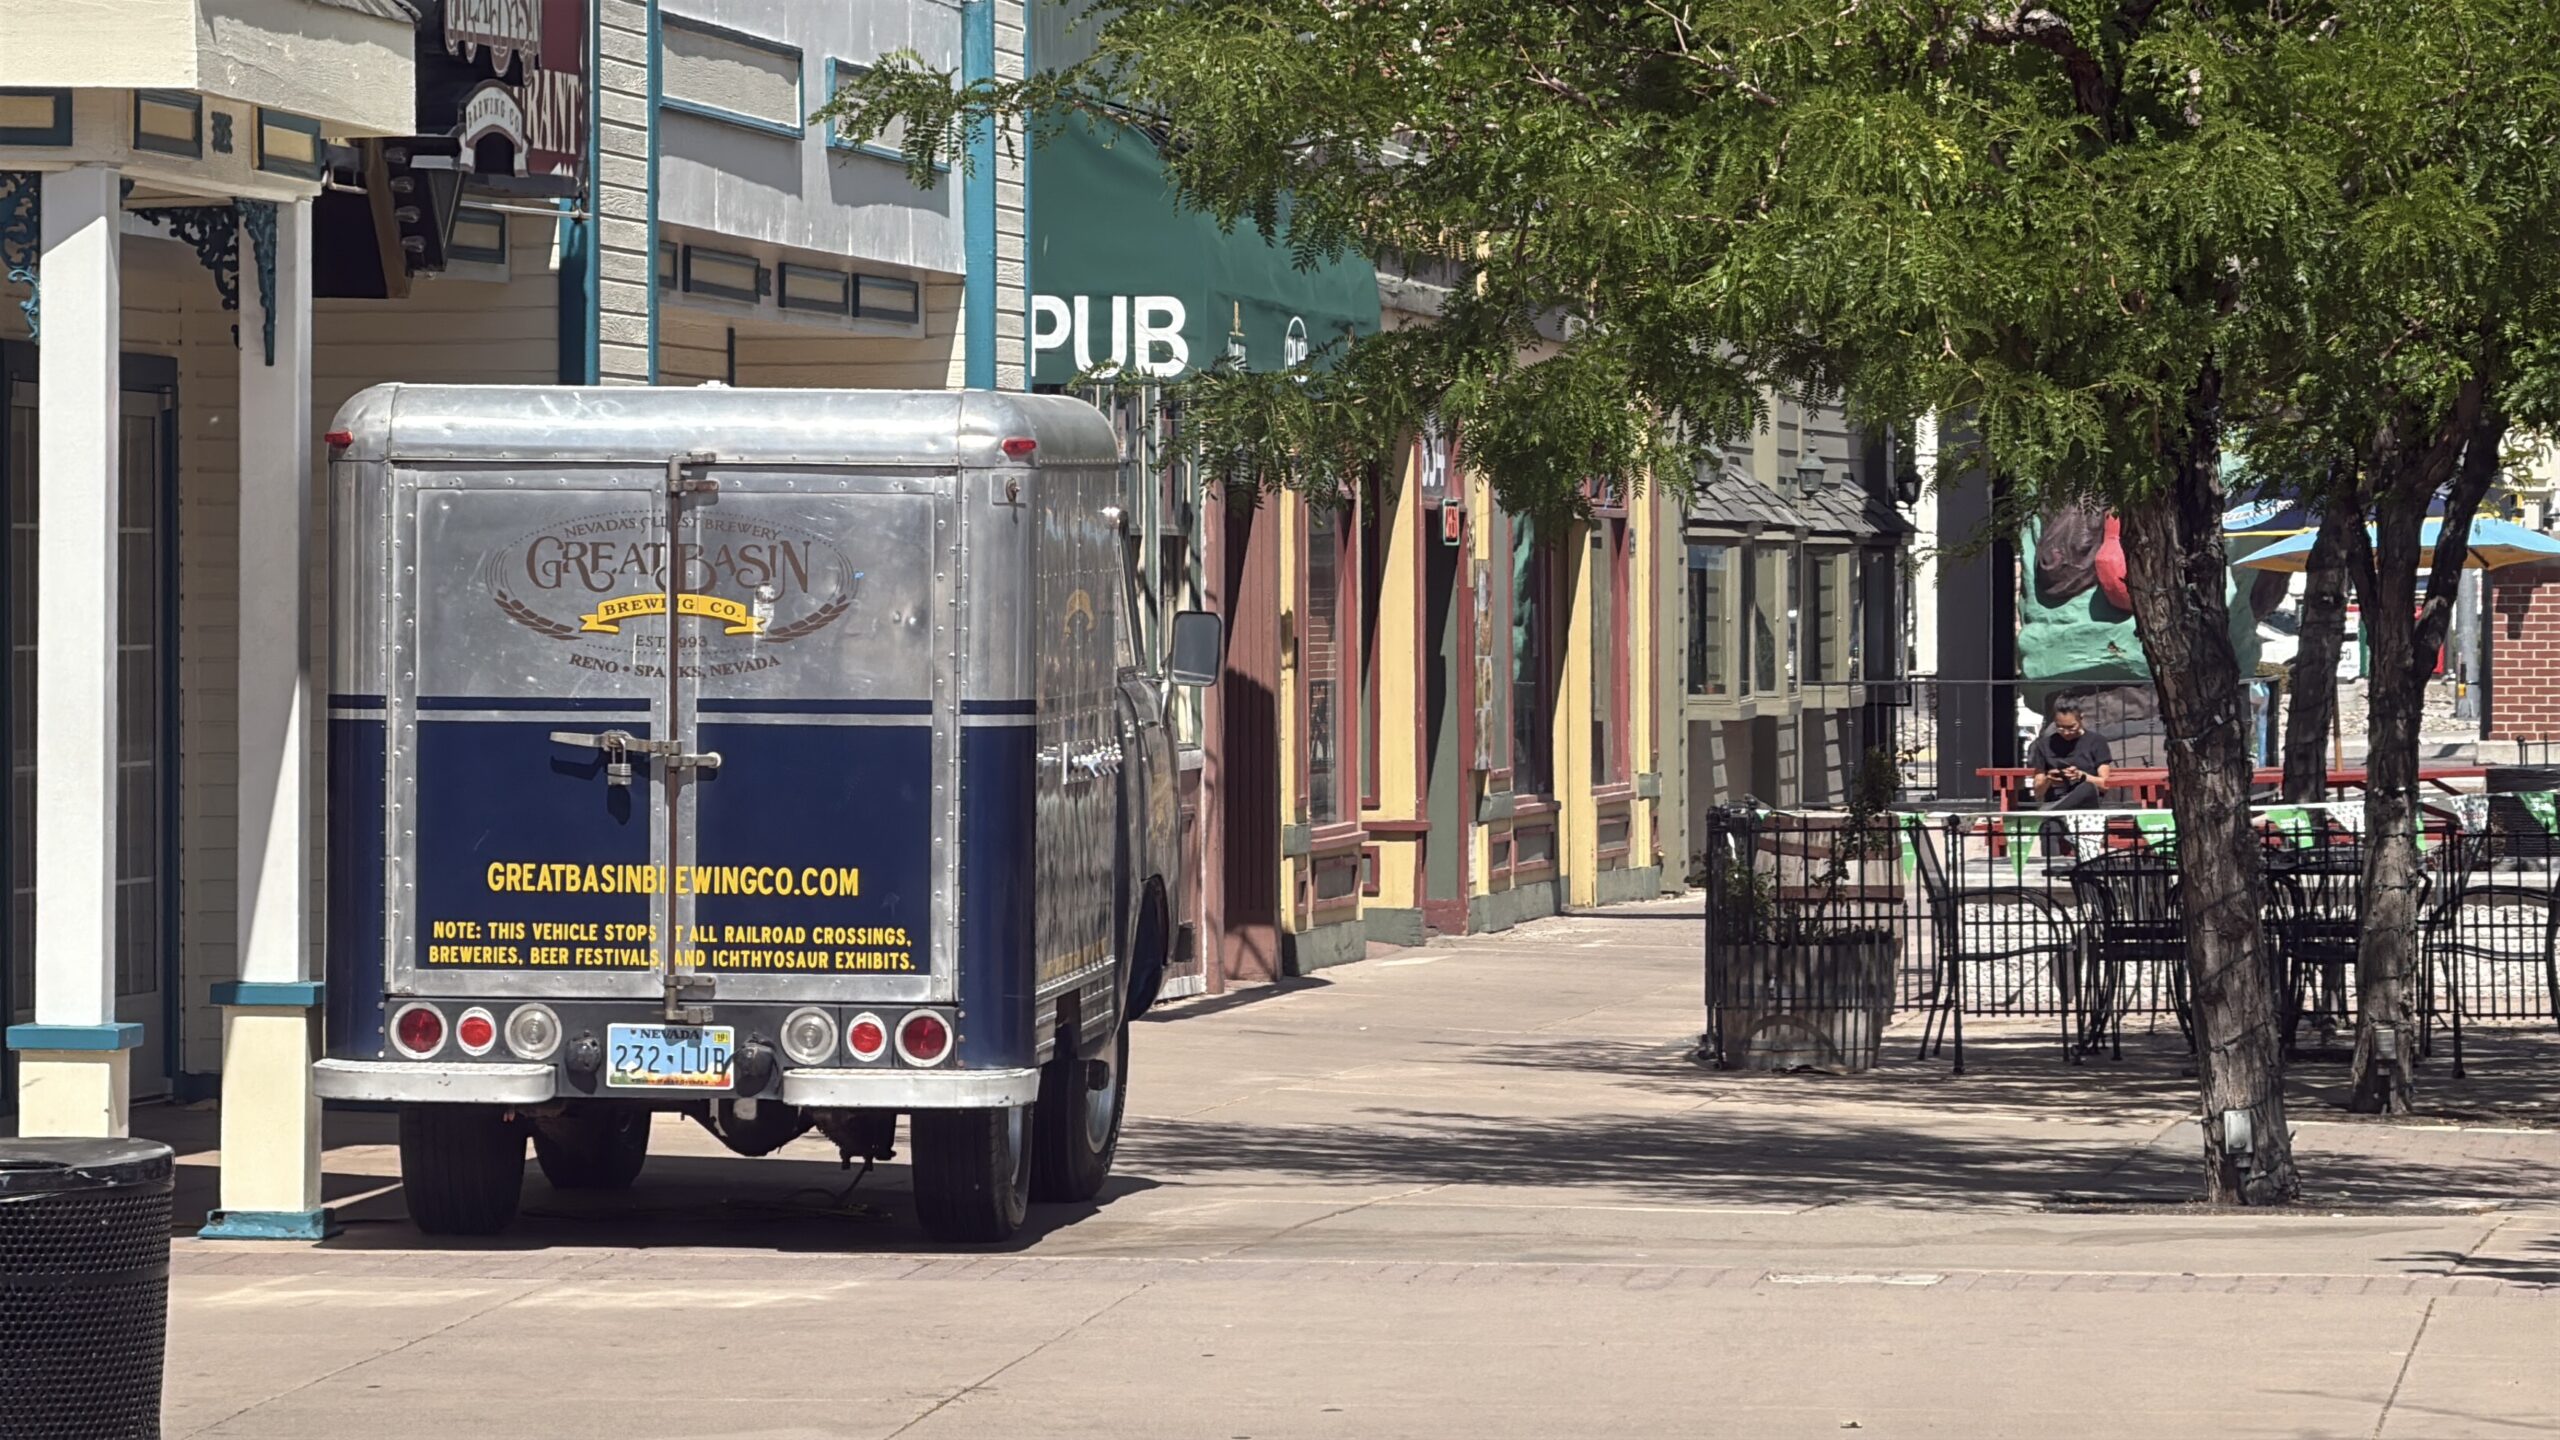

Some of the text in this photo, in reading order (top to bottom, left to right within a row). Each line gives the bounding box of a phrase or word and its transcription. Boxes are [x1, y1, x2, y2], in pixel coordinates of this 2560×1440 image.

[1031, 295, 1189, 378] PUB
[705, 518, 782, 540] BREWERY
[526, 536, 811, 603] GREAT BASIN
[604, 597, 741, 618] BREWIG CO.
[678, 635, 708, 648] 993
[569, 653, 782, 678] RENO SPAKS, NEVADA
[433, 920, 481, 939] NOTE:
[488, 922, 525, 940] THIS
[532, 922, 598, 941] VEHICLE
[604, 924, 657, 942] STOPS
[689, 926, 717, 943] ALL
[724, 926, 806, 944] RAILROAD
[812, 927, 912, 947] CROSSINGS,
[429, 945, 523, 966] BREWERIES,
[530, 947, 569, 965] BEER
[674, 950, 706, 967] AND
[713, 950, 828, 969] ICHTHYOSAUR
[835, 951, 916, 970] EXHIBITS.
[640, 1028, 700, 1040] NEVADA
[615, 1045, 661, 1074] 232
